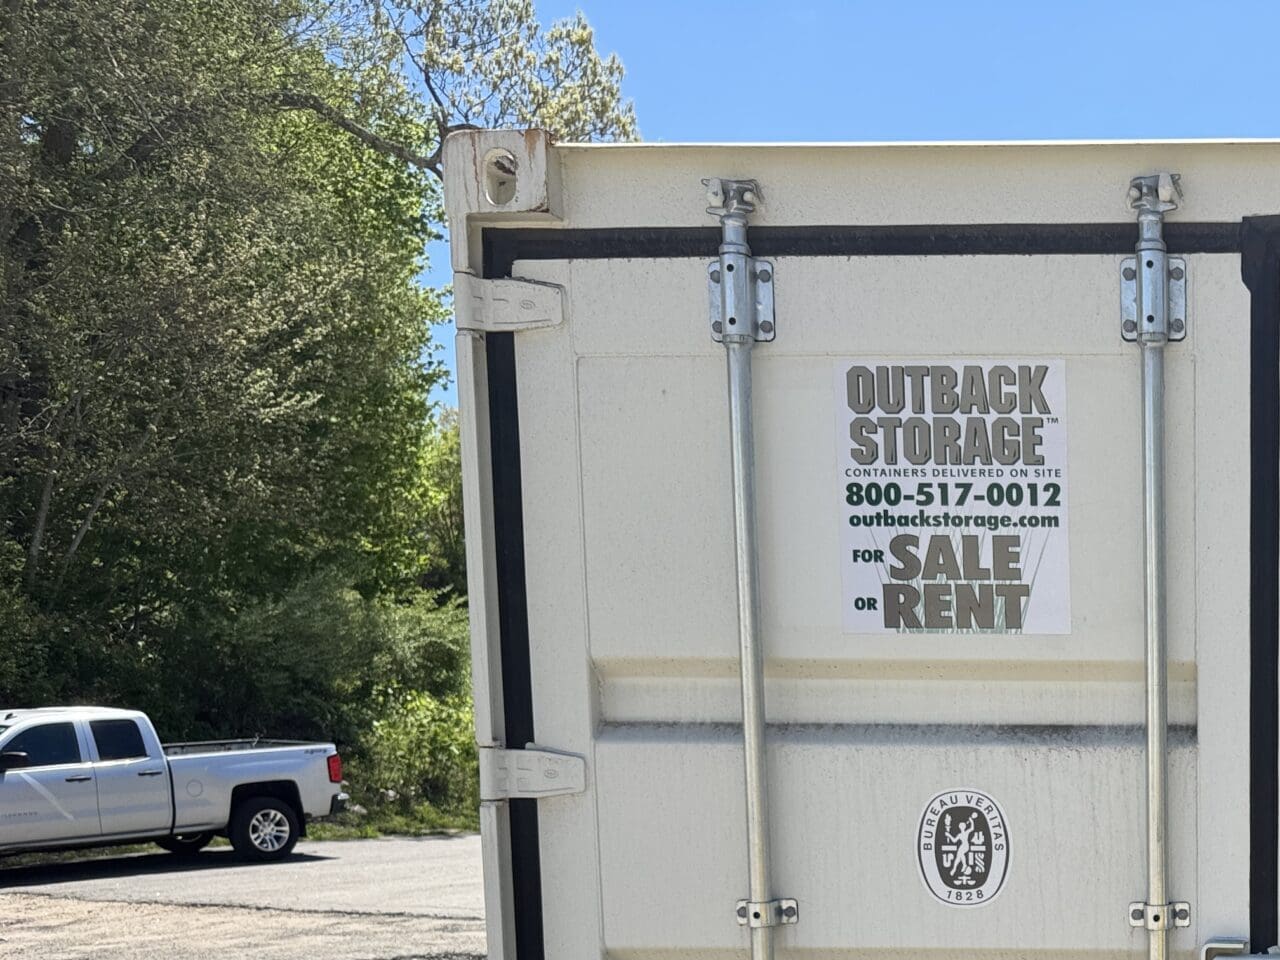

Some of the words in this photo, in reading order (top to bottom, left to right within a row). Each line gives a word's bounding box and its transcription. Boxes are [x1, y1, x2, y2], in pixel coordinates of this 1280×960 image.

[846, 365, 1052, 415] OUTBACK
[849, 416, 1045, 466] STORAGE
[845, 468, 927, 478] CONTAINERS
[932, 468, 1004, 478] DELIVERED
[1009, 468, 1029, 478] ON
[1034, 468, 1062, 478] SITE
[845, 482, 1061, 507] 800-517-0012
[849, 509, 1060, 531] outbackstorage.com
[852, 549, 885, 563] FOR
[888, 533, 1022, 581] SALE
[854, 597, 878, 611] OR
[882, 583, 1029, 630] RENT
[923, 795, 958, 851] BUREAU
[965, 795, 1004, 851] VERITAS
[946, 889, 984, 901] 1828
